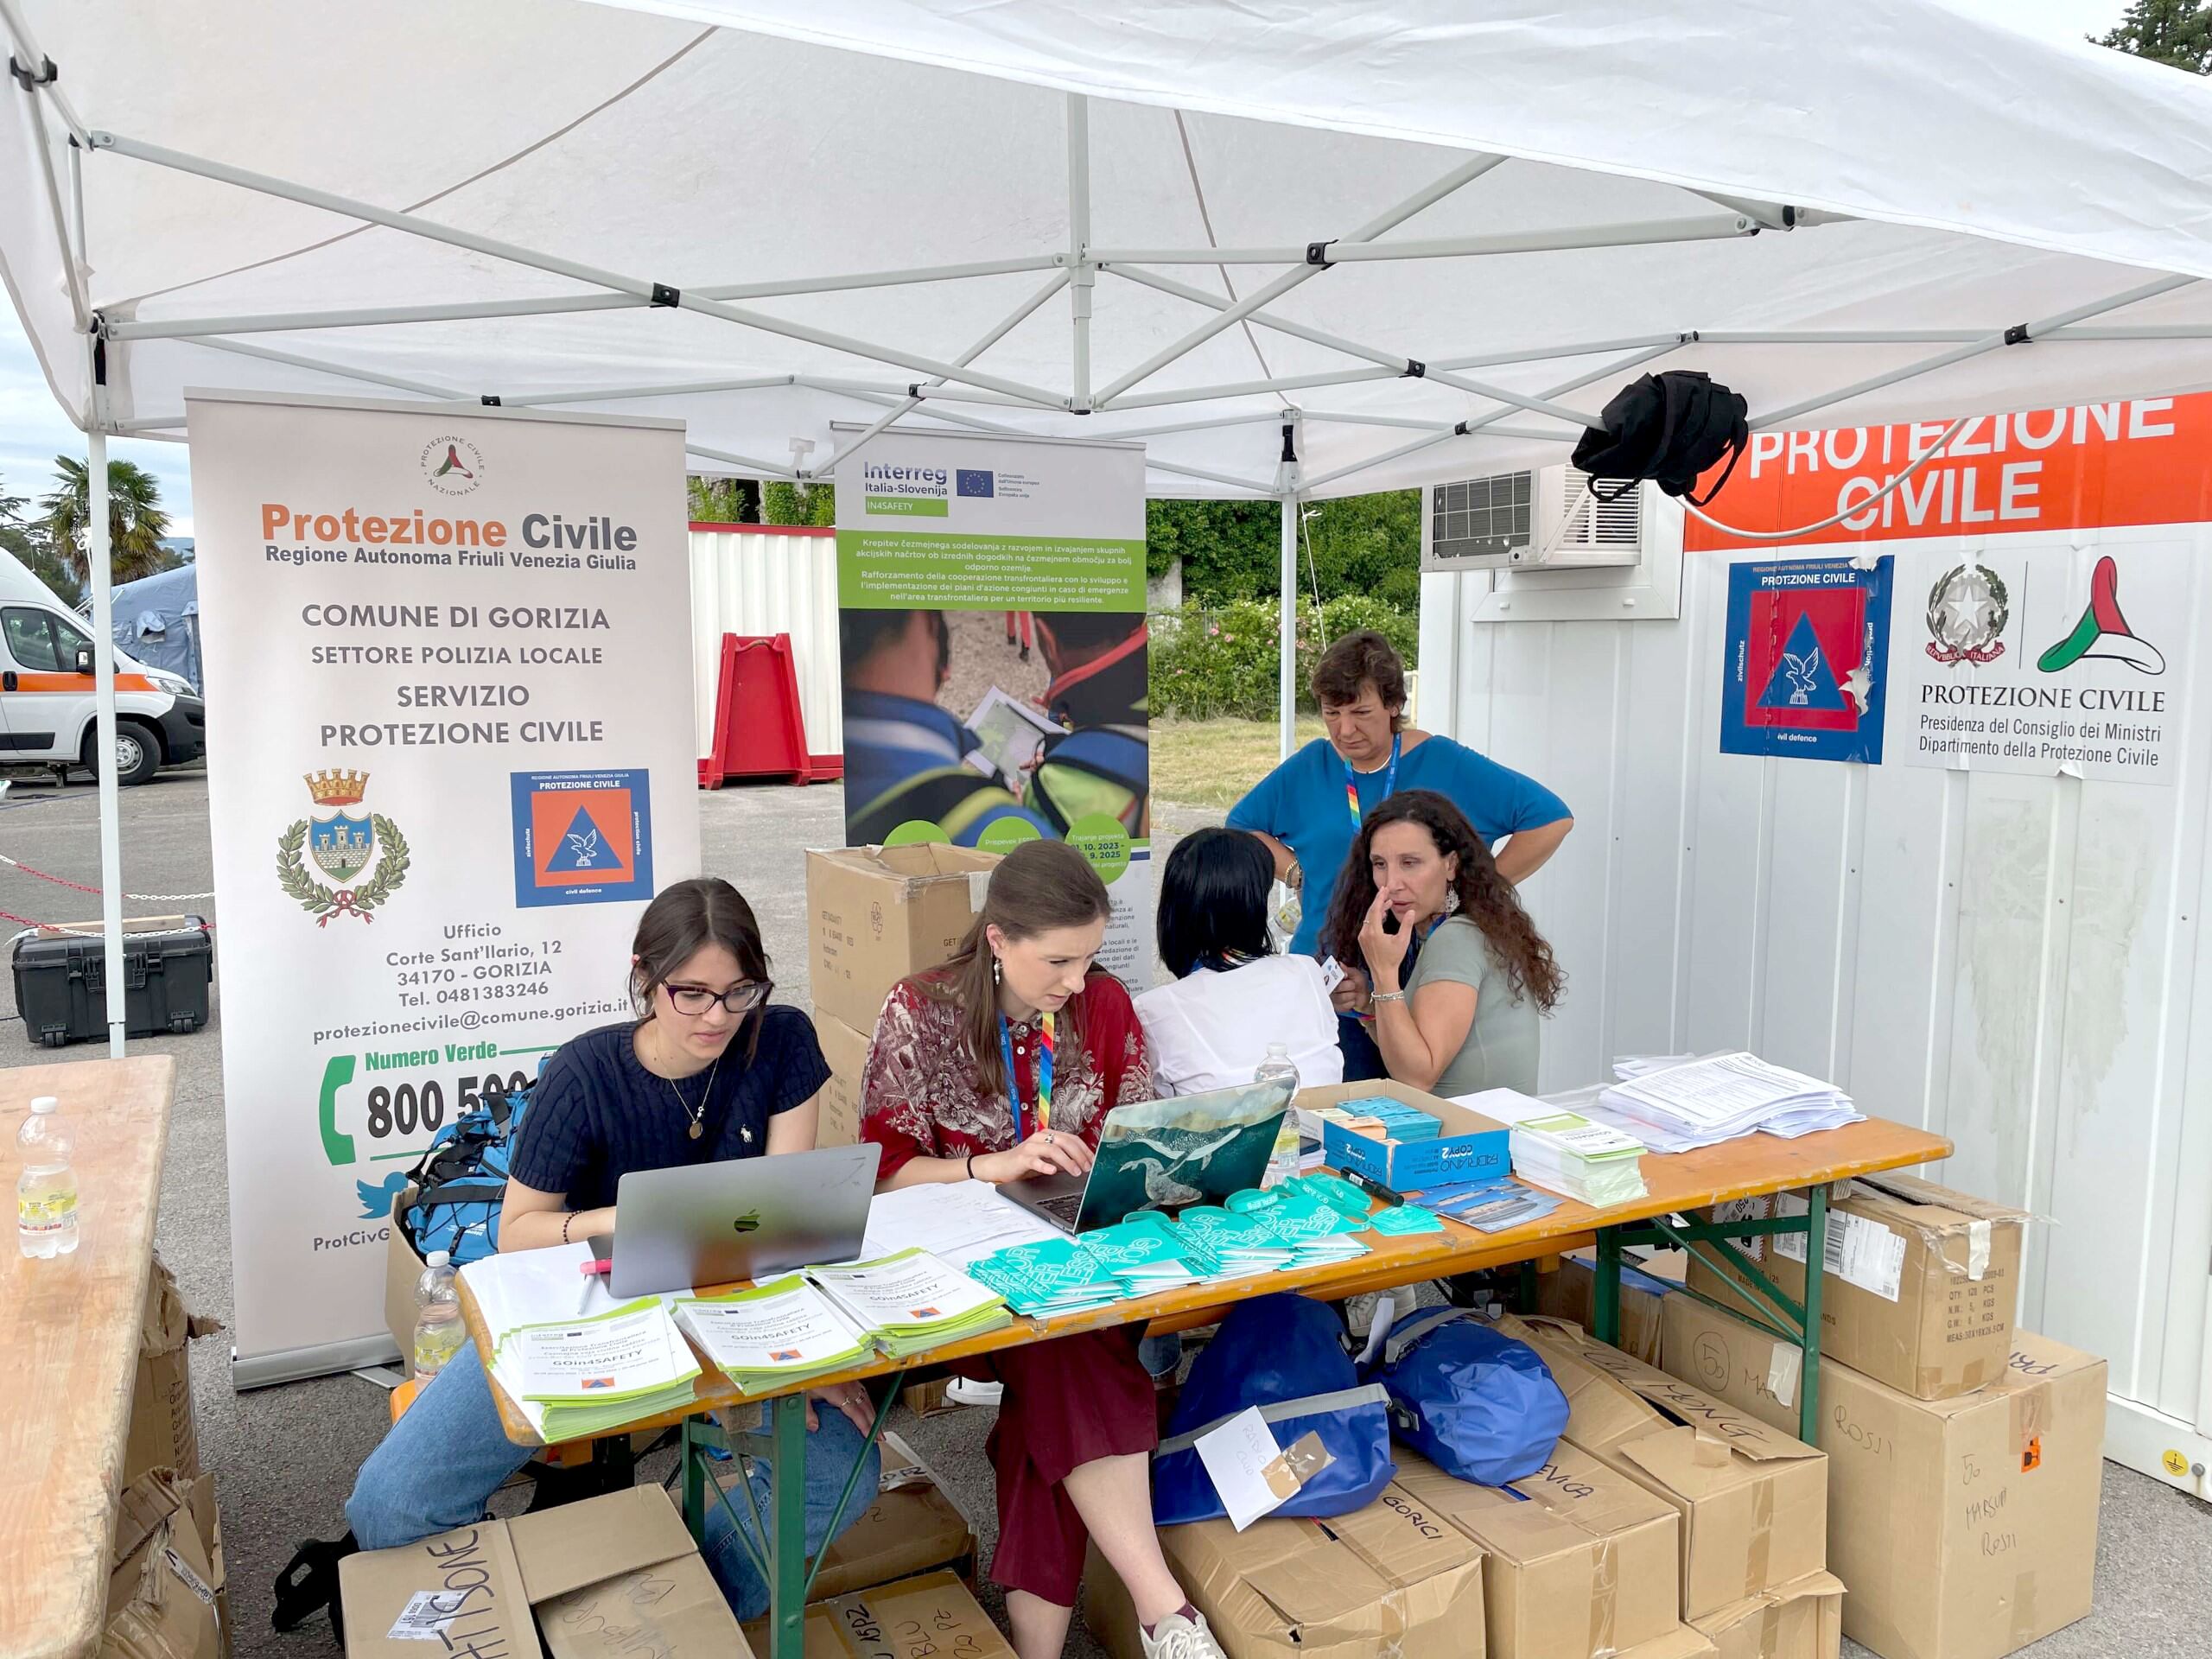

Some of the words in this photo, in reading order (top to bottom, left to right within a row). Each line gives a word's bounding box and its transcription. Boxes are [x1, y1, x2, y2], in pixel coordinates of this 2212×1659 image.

[421, 435, 466, 467] PROTEZIONE
[467, 442, 485, 470] CIVILE
[864, 461, 947, 485] Interreg
[428, 479, 480, 497] NAZIONALE
[865, 483, 947, 497] Italia-Slovenija
[1837, 461, 2043, 531] CIVILE
[867, 501, 913, 511] IN4SAFETY
[261, 504, 506, 547] Protezione
[522, 513, 638, 551] Civile
[862, 539, 899, 548] Krepitev
[952, 542, 1000, 551] sodelovanja
[265, 545, 347, 565] Regione
[353, 547, 452, 565] Autonoma
[458, 549, 505, 567] Friuli
[510, 552, 580, 569] Venezia
[586, 553, 636, 571] Giulia
[1004, 575, 1062, 583] transfrontaliera
[1012, 585, 1047, 594] congiunti
[1822, 573, 1855, 583] CIVILE
[302, 604, 438, 627] COMUNE
[450, 607, 479, 628] DI
[488, 607, 610, 631] GORIZIA
[311, 646, 412, 664] SETTORE
[422, 646, 512, 664] POLIZIA
[520, 647, 602, 665] LOCALE
[397, 685, 530, 708] SERVIZIO
[1921, 684, 2072, 709] PROTEZIONE
[2079, 689, 2164, 712] CIVILE
[321, 722, 510, 747] PROTEZIONE
[519, 721, 603, 743] CIVILE
[1789, 734, 1817, 743] defence
[1921, 715, 1984, 732] Presidenza
[1989, 718, 2008, 734] del
[2013, 719, 2075, 739] Consiglio
[2080, 722, 2100, 738] dei
[2105, 723, 2161, 742] Ministri
[1919, 736, 1999, 755] Dipartimento
[2004, 741, 2036, 758] della
[2041, 743, 2112, 763] Protezione
[2117, 747, 2159, 766] Civile
[539, 781, 592, 790] PROTEZIONE
[443, 923, 501, 939] Ufficio
[386, 950, 435, 967] Corte
[441, 944, 534, 965] Sant'Ilario,
[542, 940, 563, 955] 12
[397, 969, 456, 987] 34170
[474, 961, 552, 982] GORIZIA
[398, 991, 430, 1007] Tel.
[436, 981, 549, 1003] 0481383246
[313, 999, 628, 1045] protezionecivile@comune.gorizia.it
[365, 1046, 440, 1072] Numero
[445, 1040, 498, 1064] Verde
[367, 1082, 444, 1139] 800
[313, 1226, 391, 1252] ProtCivG
[869, 1283, 938, 1301] GOin4SAFETY
[731, 1323, 810, 1340] GOin4SAFETY
[553, 1349, 643, 1366] GOin4SAFETY
